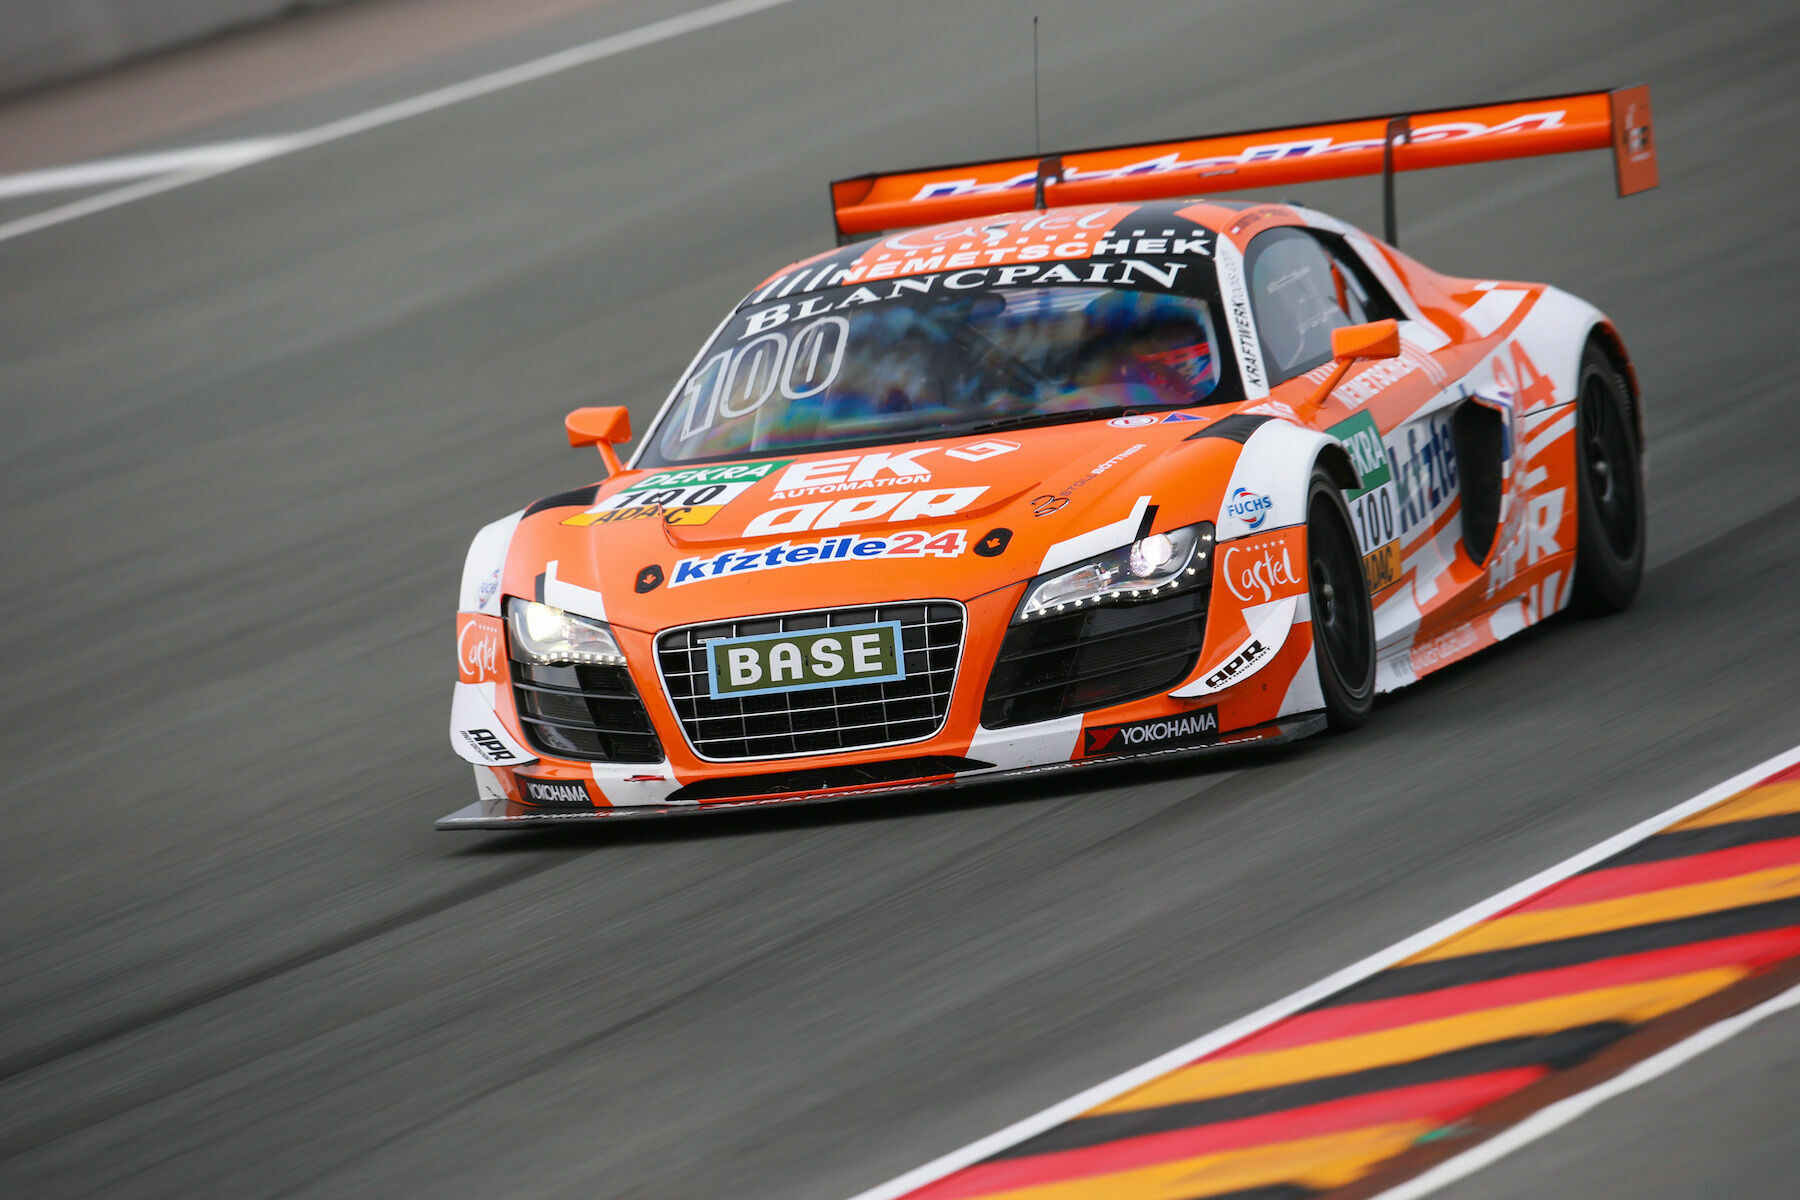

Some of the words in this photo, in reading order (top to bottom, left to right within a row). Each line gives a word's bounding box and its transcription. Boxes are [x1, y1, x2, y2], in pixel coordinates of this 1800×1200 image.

[827, 238, 1212, 287] NEMETSCHEK
[738, 259, 1187, 341] BLANCPAIN
[679, 315, 849, 442] 100
[631, 463, 773, 490] DEKRA
[769, 473, 932, 501] AUTOMATION
[774, 446, 943, 493] EK
[590, 506, 692, 526] ADAC
[615, 485, 727, 509] 100
[1228, 495, 1272, 519] FUCHS
[1357, 487, 1393, 552] 100
[673, 530, 967, 585] kfzteile24
[1223, 546, 1301, 602] Castel
[458, 619, 498, 682] Castel
[728, 632, 884, 687] BASE
[1121, 713, 1217, 745] YOKOHAMA
[526, 781, 591, 802] YOKOHAMA
